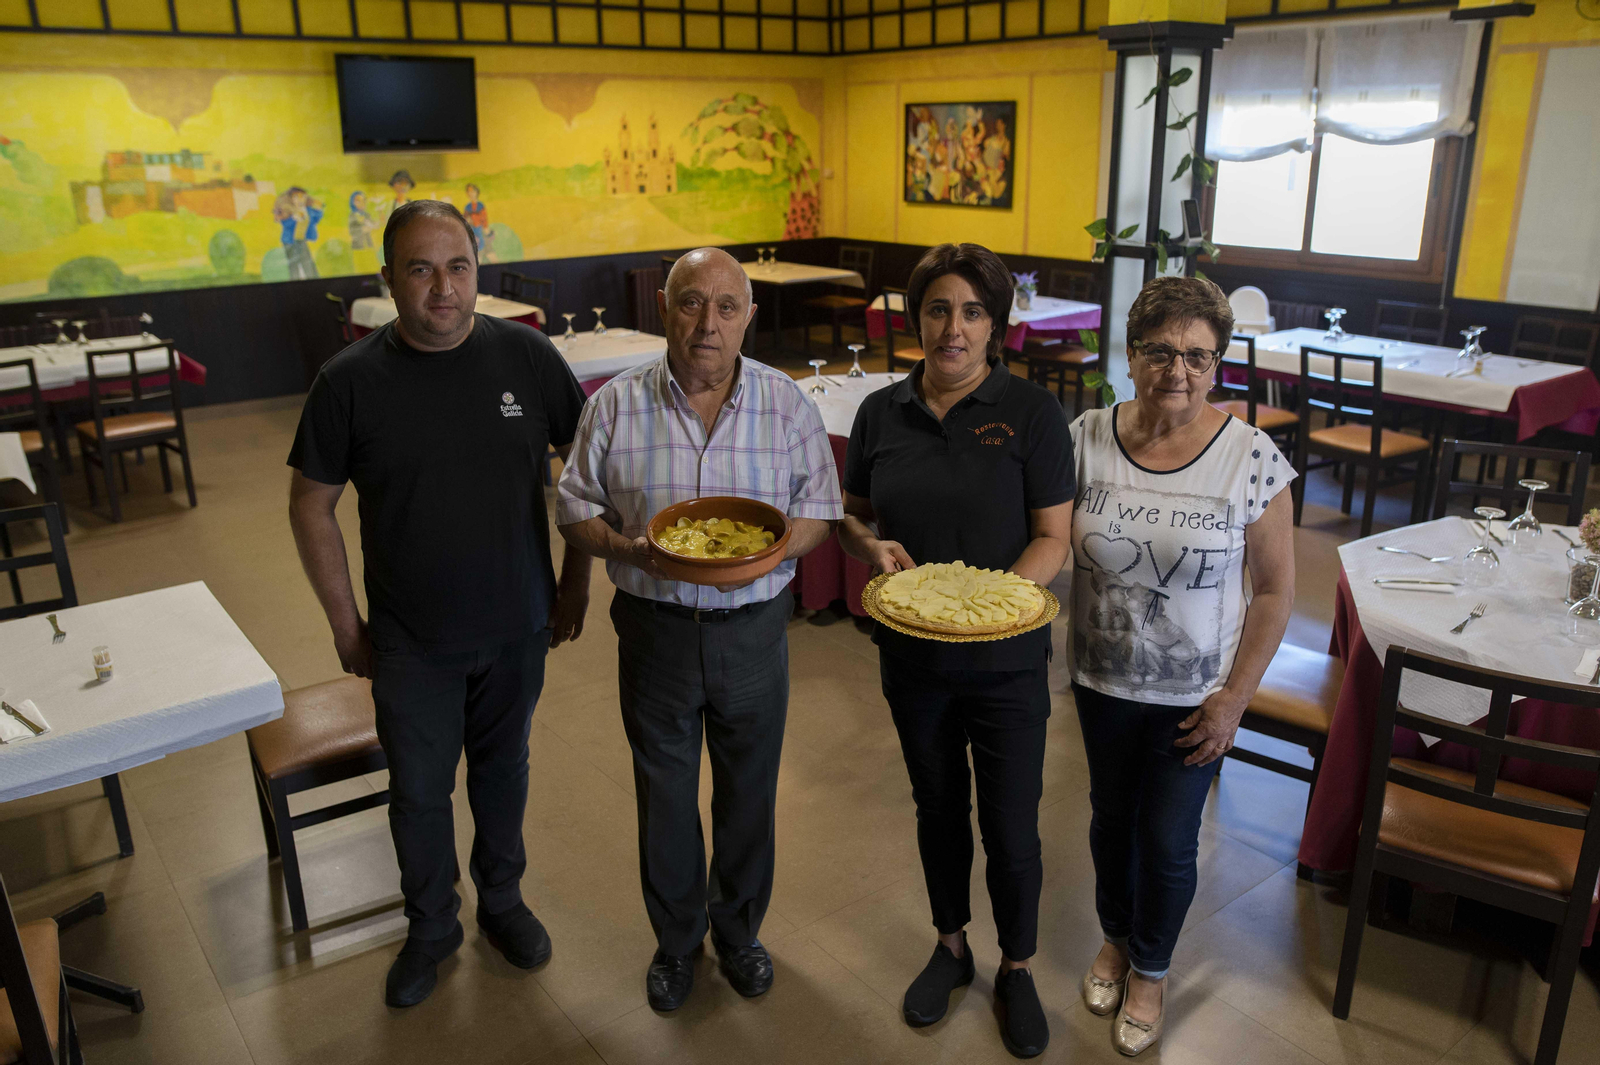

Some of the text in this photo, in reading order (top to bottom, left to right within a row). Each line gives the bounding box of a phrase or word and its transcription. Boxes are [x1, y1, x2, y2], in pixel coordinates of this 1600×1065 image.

[500, 404, 522, 412] Estrella
[502, 409, 523, 417] Galicia
[1076, 486, 1231, 533] All we need
[1108, 520, 1121, 534] is
